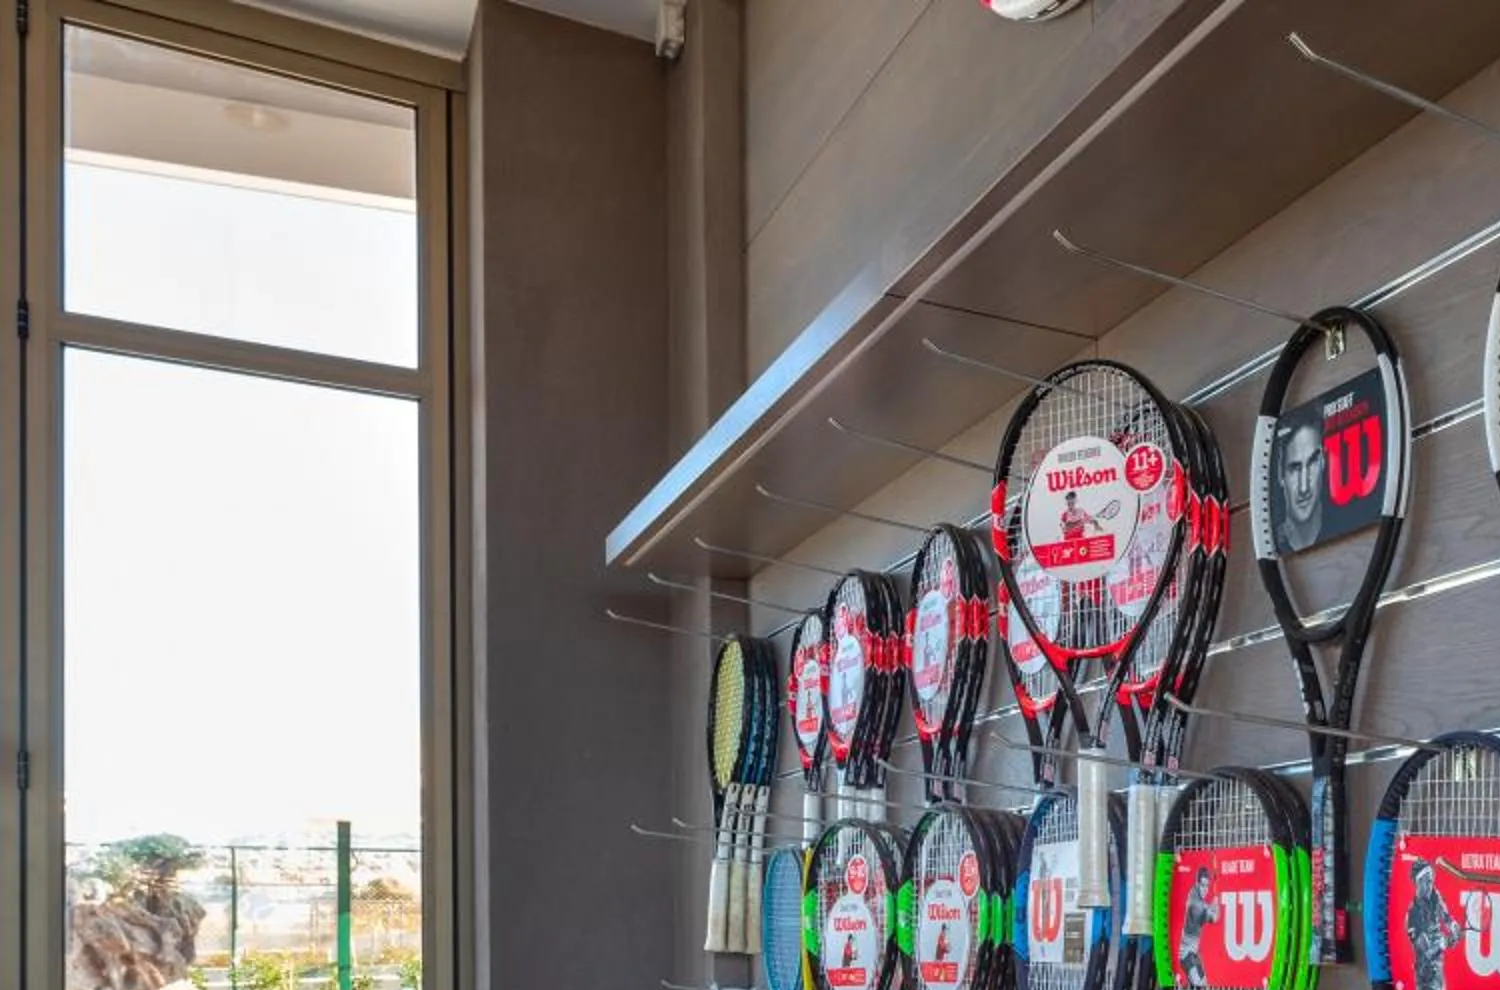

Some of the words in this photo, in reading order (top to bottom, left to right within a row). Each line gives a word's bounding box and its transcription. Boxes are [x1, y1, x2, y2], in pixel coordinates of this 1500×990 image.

[1046, 465, 1117, 492] Wilson
[928, 902, 961, 921] Wilson
[833, 915, 867, 932] Wilson
[1220, 890, 1274, 964] W
